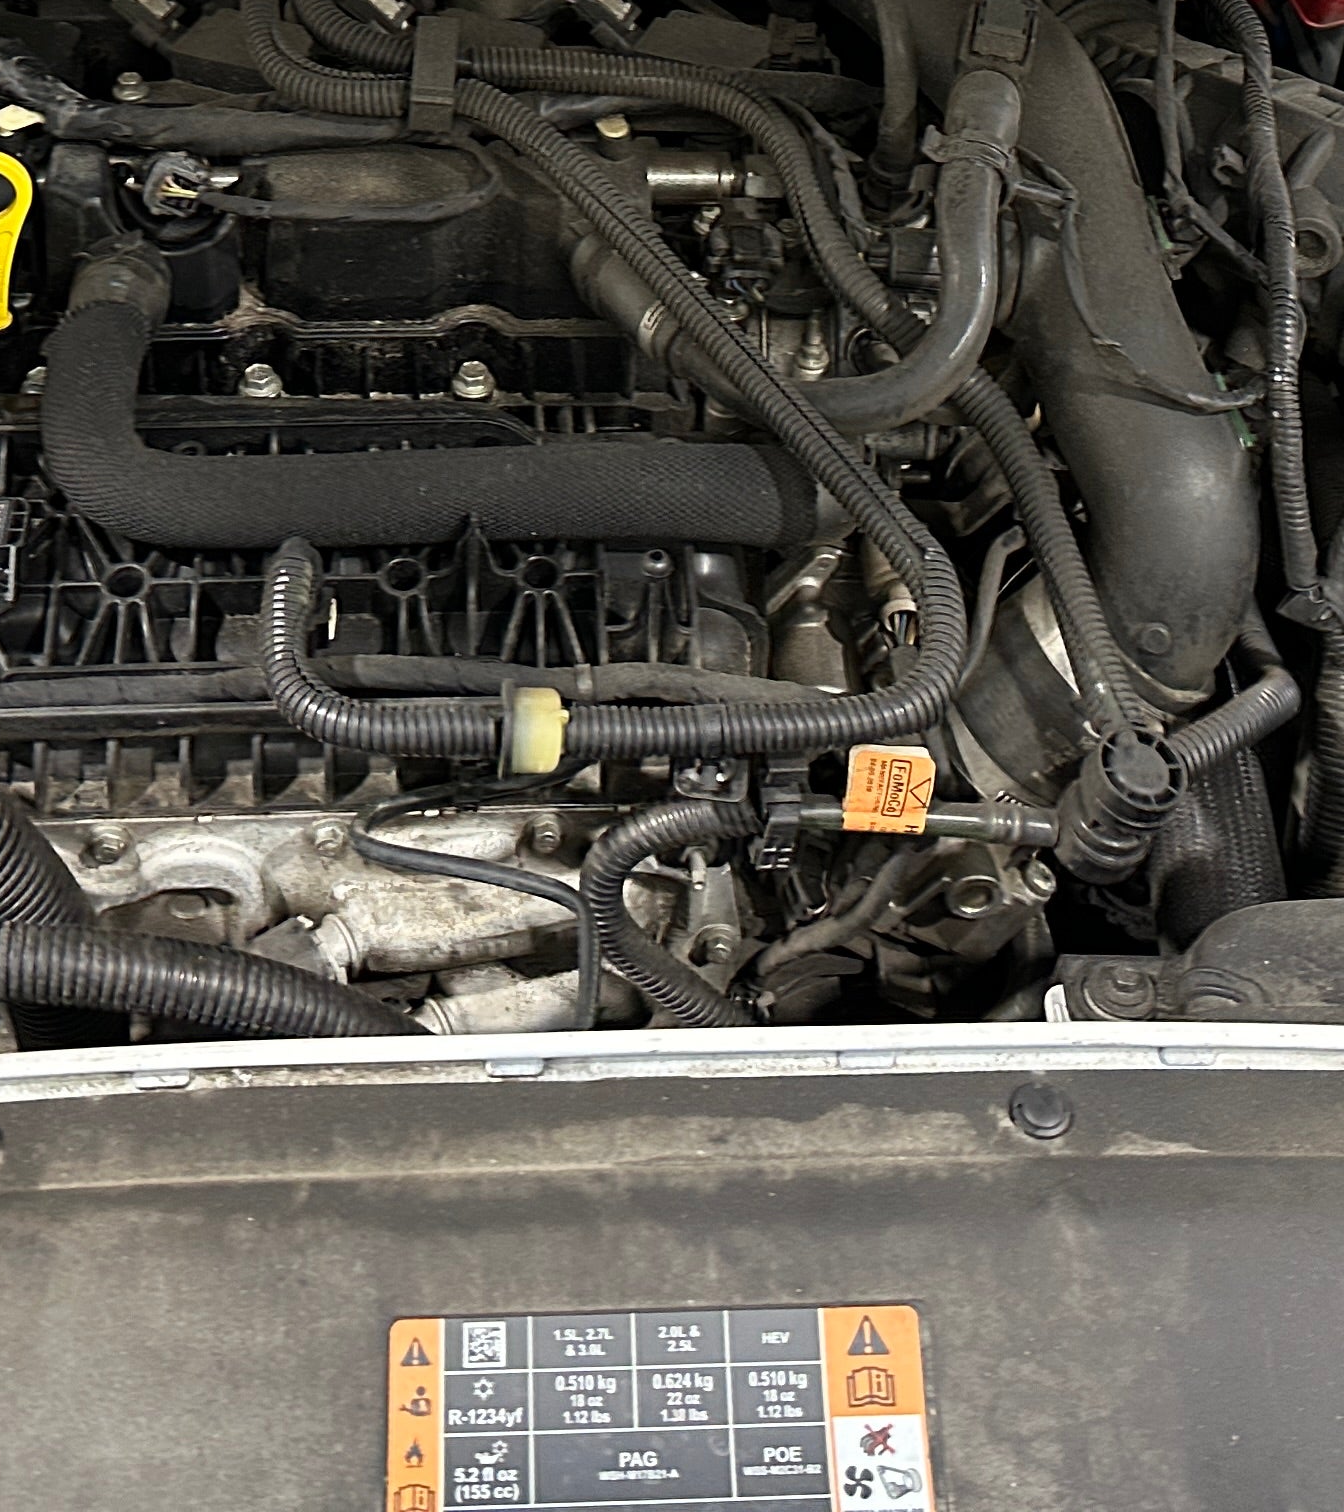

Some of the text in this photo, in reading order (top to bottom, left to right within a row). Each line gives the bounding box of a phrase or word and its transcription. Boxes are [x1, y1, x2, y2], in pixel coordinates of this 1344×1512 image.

[886, 766, 907, 813] FoMoCo
[554, 1327, 614, 1341] 1.5L, 2.7L
[657, 1325, 701, 1338] 2.0L &
[761, 1332, 790, 1344] HEV
[565, 1344, 606, 1356] & 3.0L
[666, 1340, 697, 1352] 2.5L
[555, 1375, 617, 1394] 0.510 kg
[652, 1373, 714, 1391] 0.624 kg
[748, 1371, 808, 1388] 0.510 kg
[570, 1395, 604, 1407] 18 oz
[667, 1392, 702, 1405] 22 oz
[763, 1389, 796, 1402] 18 oz
[448, 1408, 523, 1427] R-1234yf
[563, 1411, 612, 1424] 1.12 lbs
[688, 1408, 709, 1421] lbs
[756, 1405, 804, 1418] 1.12 lbs
[619, 1451, 658, 1468] PAG
[763, 1446, 802, 1463] POE
[453, 1467, 519, 1483] 5.2 fl oz
[454, 1483, 520, 1503] (155 cc)
